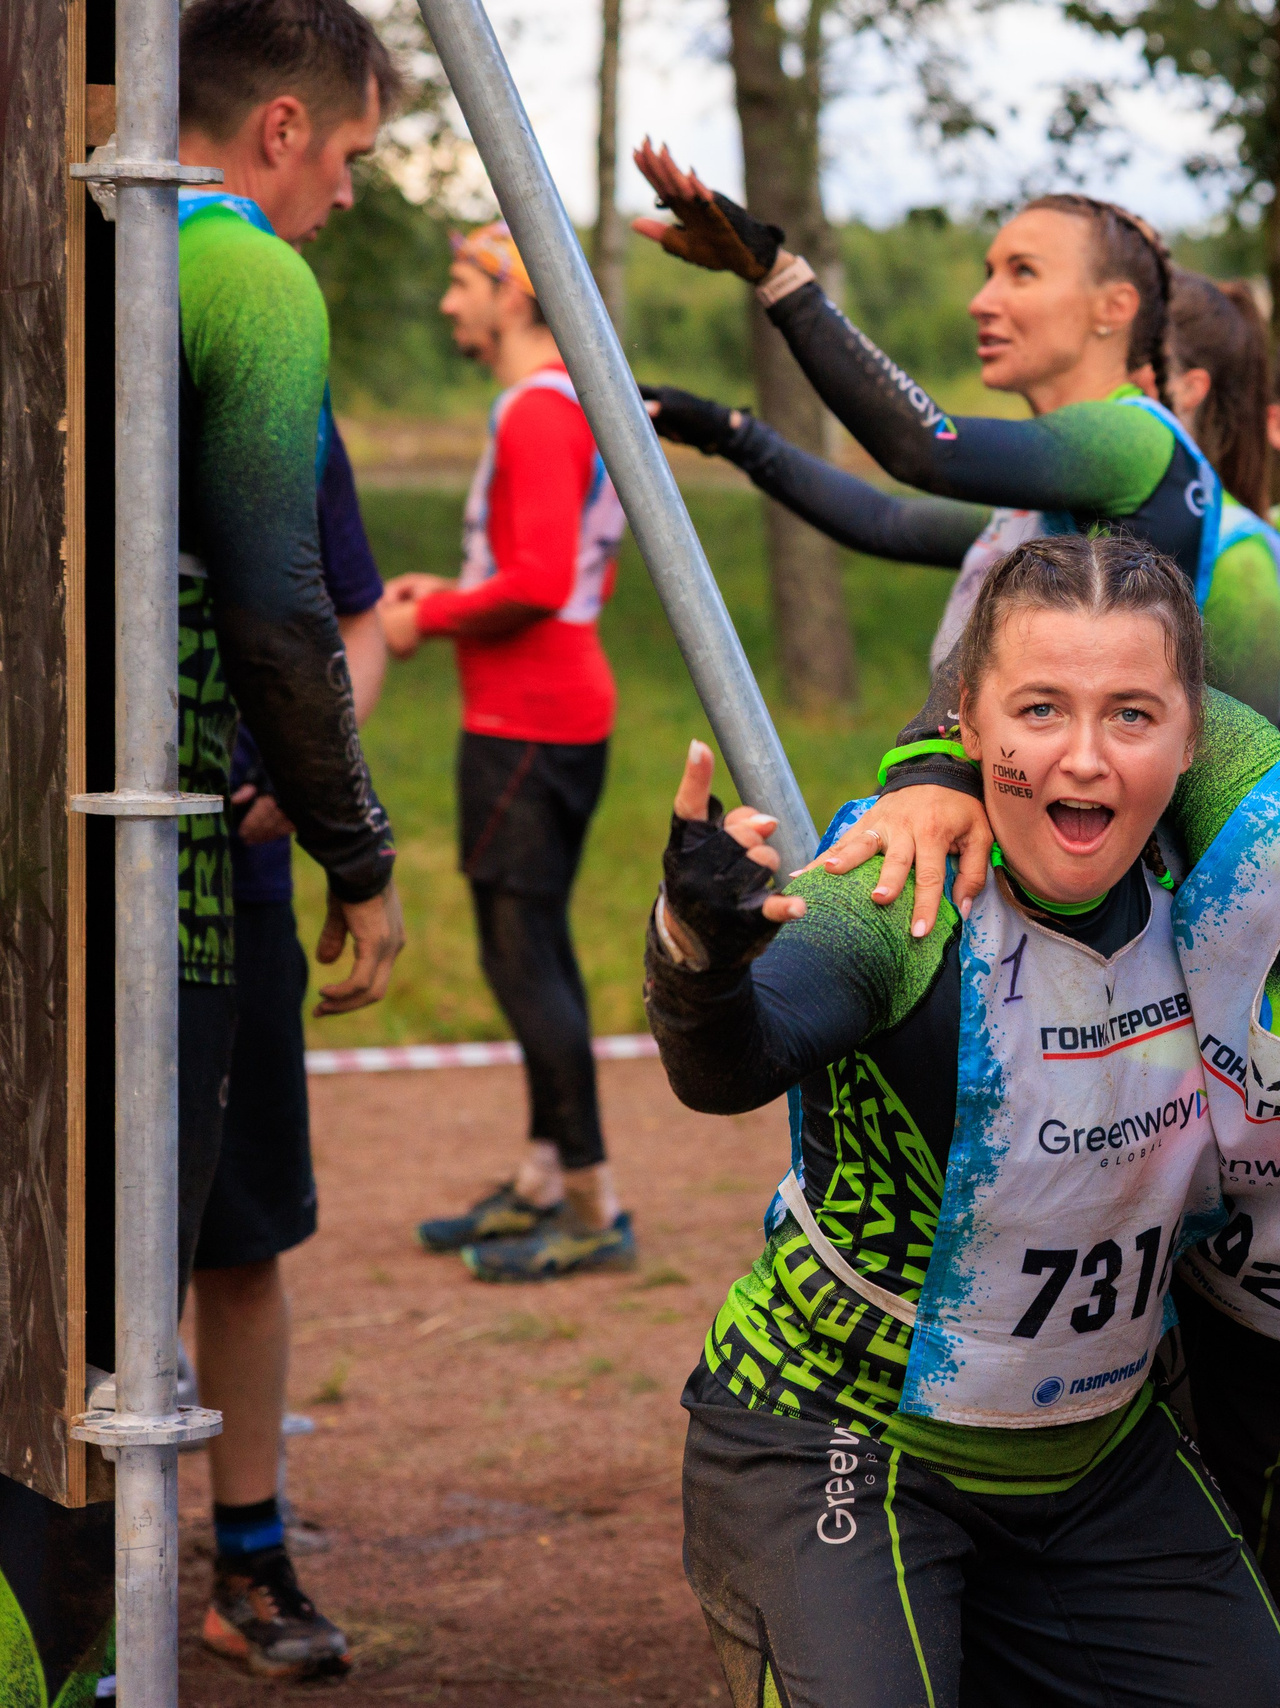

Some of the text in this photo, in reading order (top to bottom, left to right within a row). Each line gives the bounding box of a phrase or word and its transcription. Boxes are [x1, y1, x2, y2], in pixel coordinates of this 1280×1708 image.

[992, 763, 1028, 782] ГОНКА
[993, 780, 1034, 799] ГЕРОЕВ
[1000, 932, 1028, 1004] 1
[1109, 992, 1191, 1042] ГЕРОЕВ
[1038, 1093, 1194, 1155] Greenway
[1100, 1140, 1162, 1168] GLOBAL
